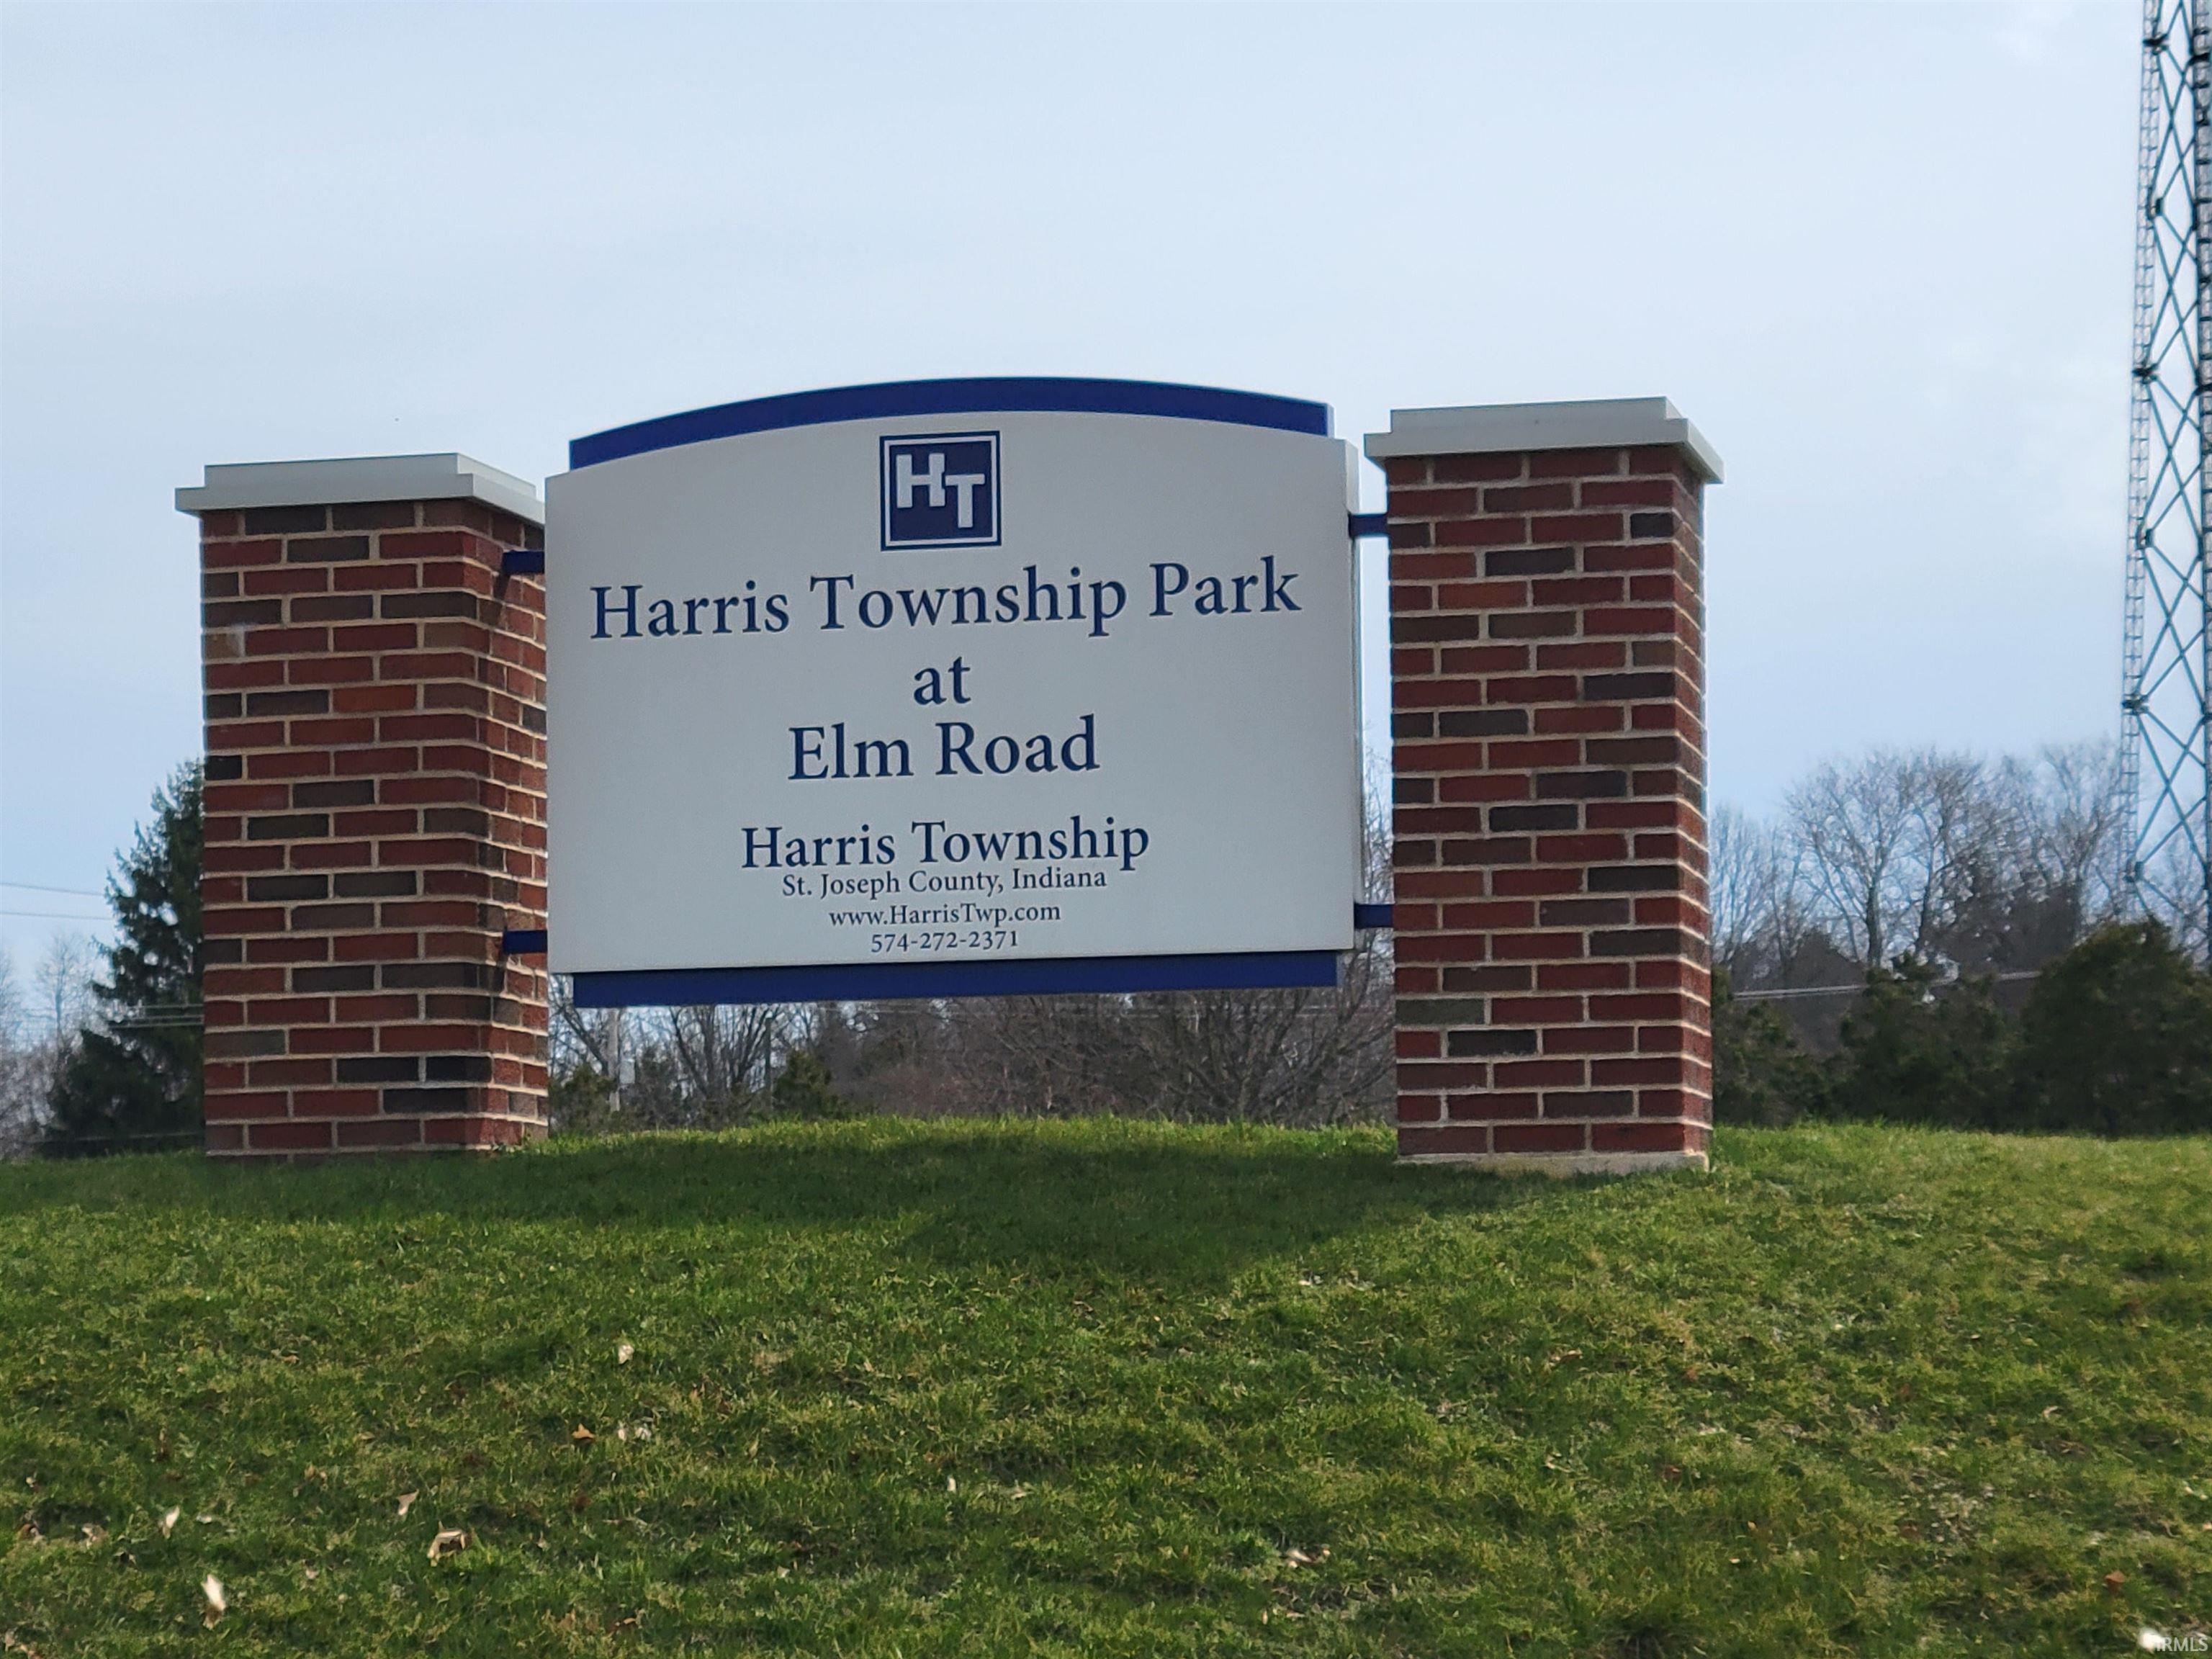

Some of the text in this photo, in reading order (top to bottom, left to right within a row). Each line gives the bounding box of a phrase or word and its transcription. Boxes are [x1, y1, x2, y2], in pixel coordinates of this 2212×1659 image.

[896, 453, 985, 528] HT
[590, 555, 1302, 639] Harris Township Park
[914, 657, 972, 706] at
[788, 714, 1100, 781] Elm Road
[742, 815, 1149, 871] Harris Township
[782, 866, 1107, 900] St. Joseph County, Indiana
[828, 902, 1061, 928] www.HarrisTwp.com
[871, 930, 1018, 953] 574-272-2371
